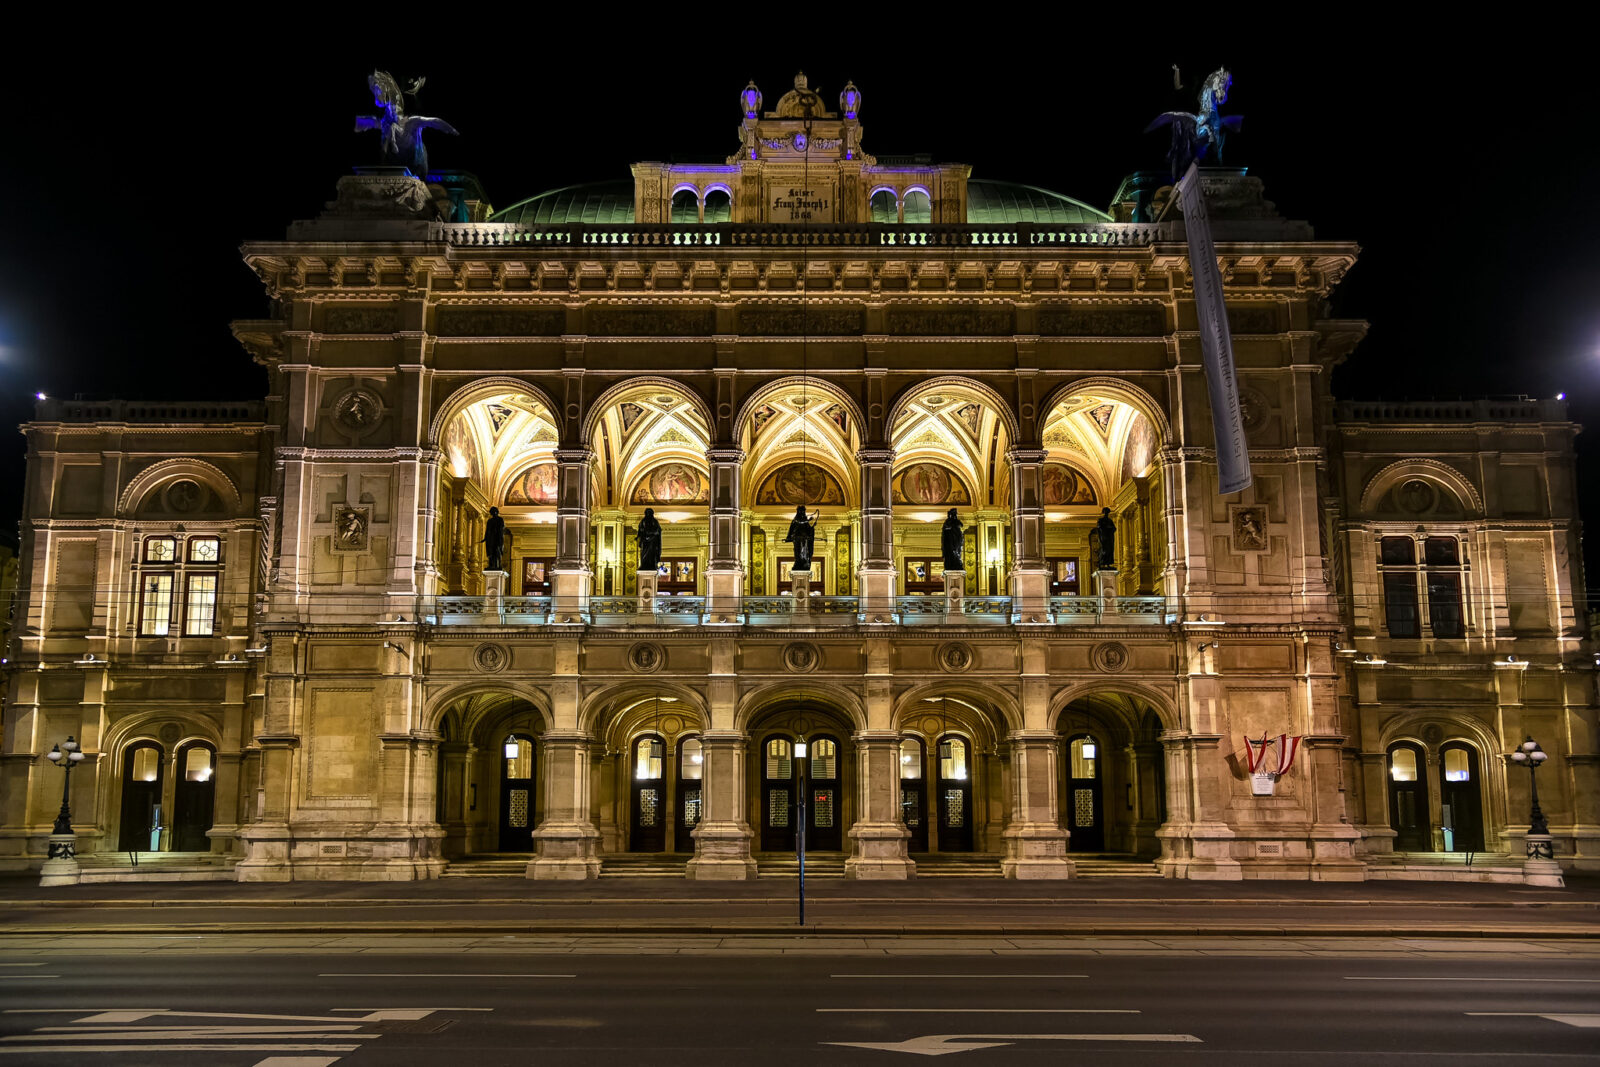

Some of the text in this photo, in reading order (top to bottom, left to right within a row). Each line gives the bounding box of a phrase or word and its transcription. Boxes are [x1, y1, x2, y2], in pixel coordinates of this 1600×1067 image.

[788, 189, 815, 198] Kaiser
[773, 197, 795, 211] Franz
[796, 197, 823, 212] Joseph
[790, 211, 812, 220] 1868
[1227, 393, 1240, 433] JAHRE
[1233, 438, 1241, 457] 150
